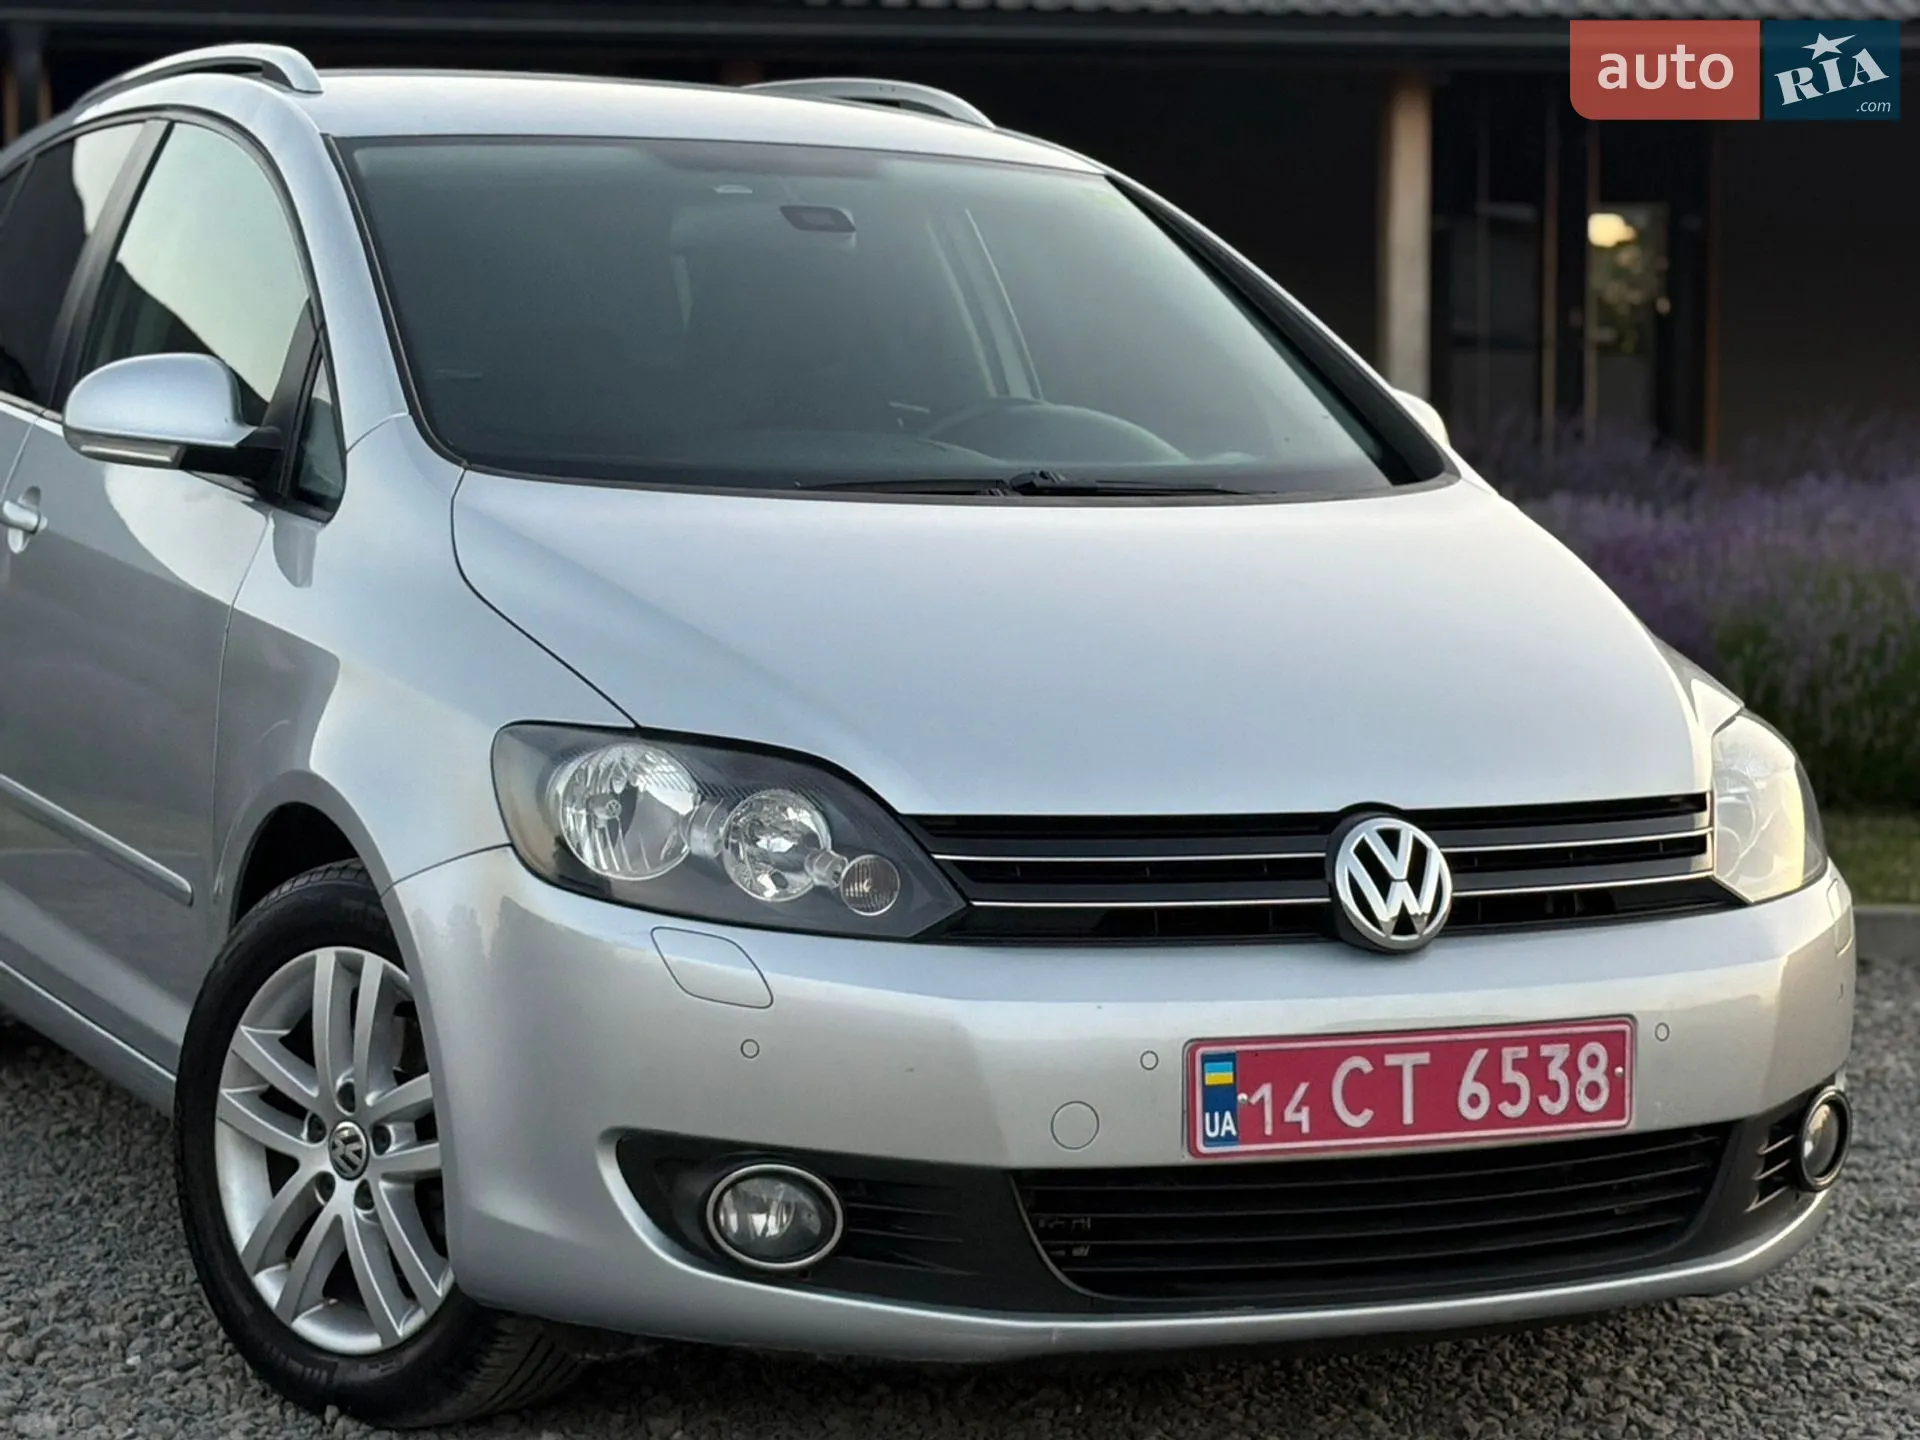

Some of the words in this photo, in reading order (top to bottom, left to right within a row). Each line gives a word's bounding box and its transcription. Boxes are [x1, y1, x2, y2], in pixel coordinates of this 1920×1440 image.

[1249, 1082, 1310, 1135] 14
[1332, 1053, 1430, 1127] CT
[1458, 1042, 1611, 1121] 6538
[1204, 1111, 1237, 1138] UA
